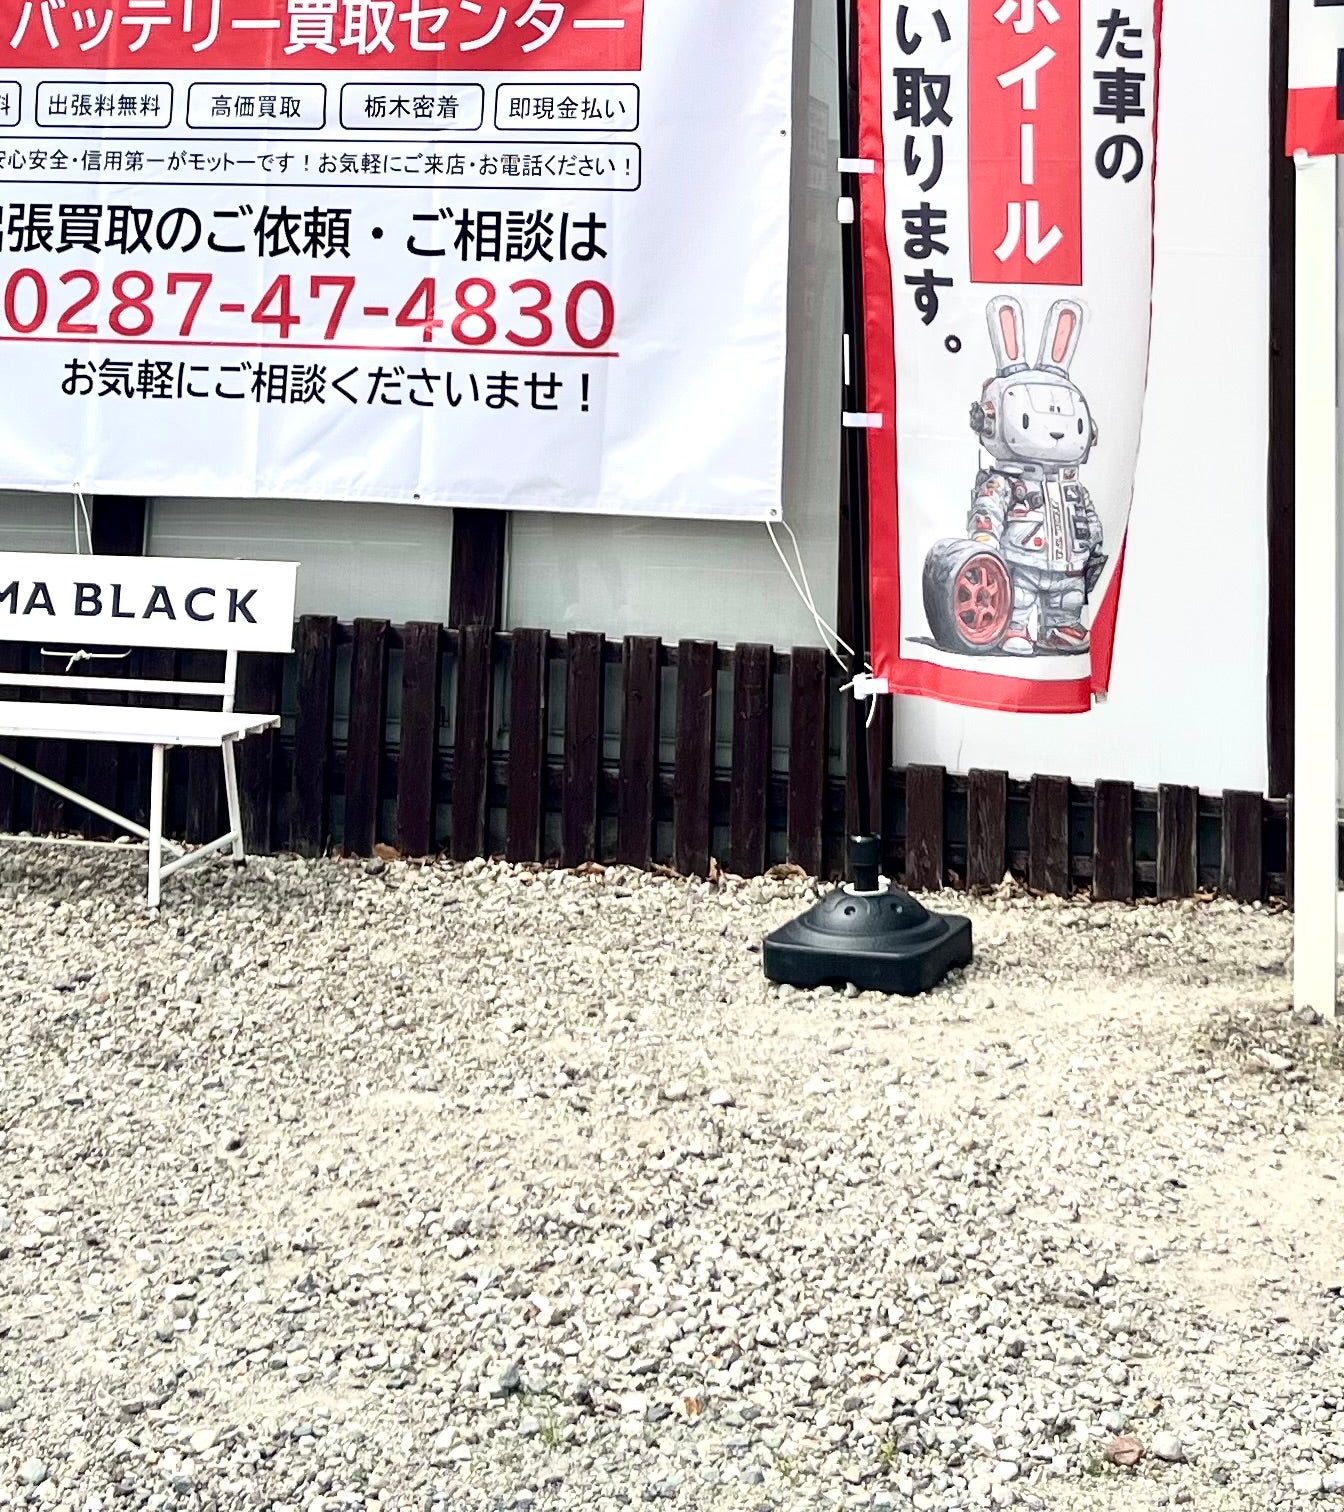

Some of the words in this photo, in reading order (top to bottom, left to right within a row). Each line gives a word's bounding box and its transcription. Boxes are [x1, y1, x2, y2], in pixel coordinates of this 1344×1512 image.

[47, 93, 161, 118] 出張料無料
[210, 94, 302, 119] 高価買取
[364, 95, 460, 120] 栃木密着
[508, 96, 627, 121] 即現金払い
[2, 267, 616, 350] 0287-47-4830
[59, 358, 591, 414] お気軽にご相談くださいませ！
[72, 581, 259, 624] BLACK
